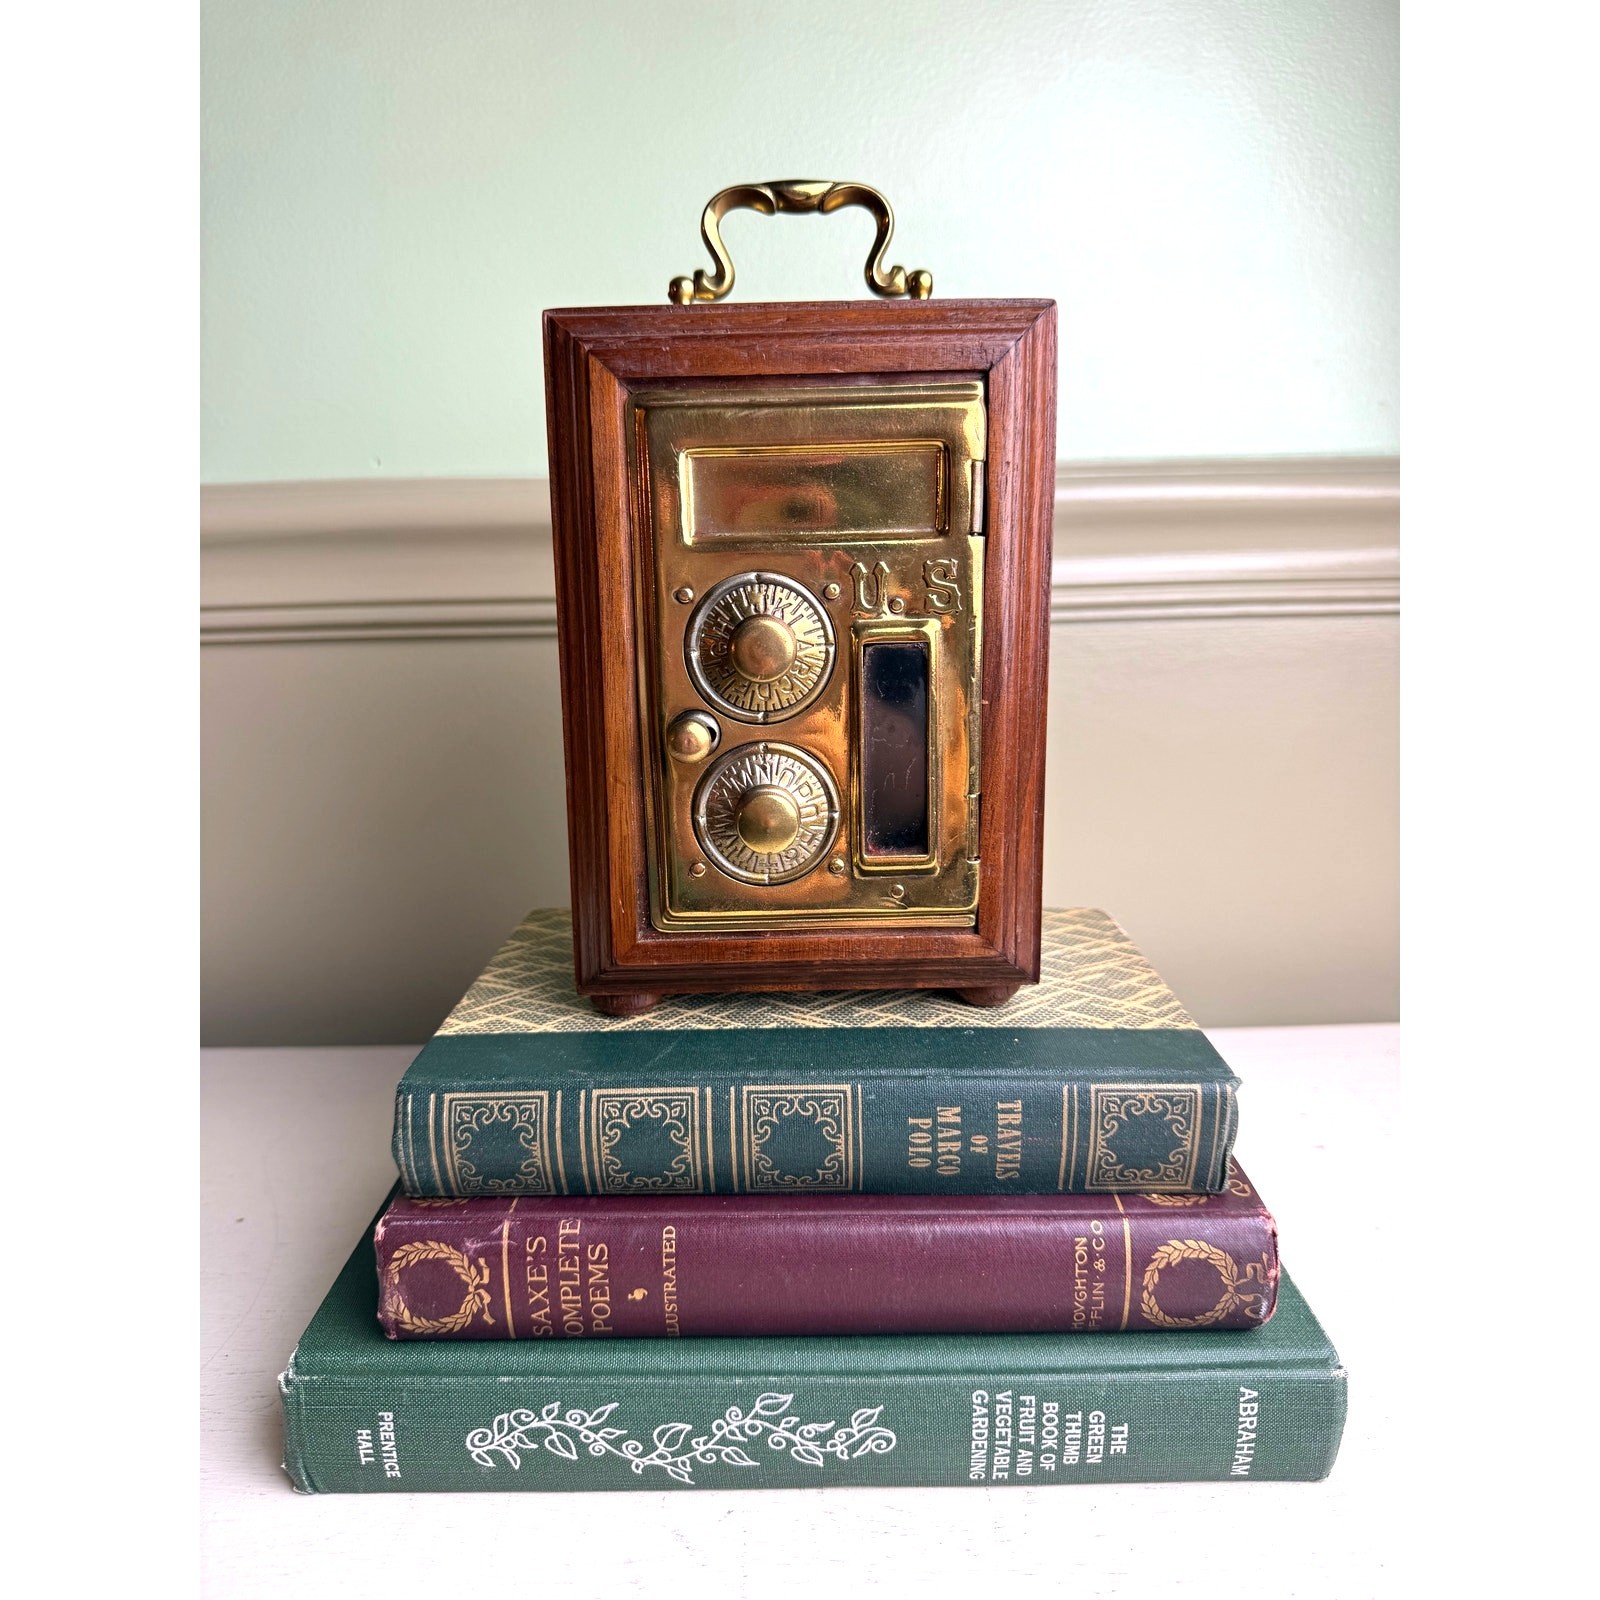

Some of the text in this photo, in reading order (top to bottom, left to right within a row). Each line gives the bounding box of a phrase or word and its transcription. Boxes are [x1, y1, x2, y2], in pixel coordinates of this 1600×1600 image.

[908, 1116, 933, 1168] POLO
[936, 1106, 962, 1176] MARCO
[970, 1134, 989, 1154] OF
[995, 1100, 1022, 1179] TRAVELS
[526, 1236, 553, 1337] SAXE'S
[558, 1218, 585, 1337] OMPLETE
[587, 1242, 613, 1333] POEMS
[662, 1225, 680, 1337] LLUSTRATED
[1088, 1281, 1105, 1330] FFLIN
[356, 1429, 375, 1465] HALL
[378, 1411, 402, 1478] PRENTICE
[969, 1389, 989, 1480] GARDENING
[992, 1390, 1012, 1480] VEGETABLE
[1016, 1395, 1036, 1476] FRUIT AND
[1039, 1402, 1059, 1472] BOOK OF
[1062, 1411, 1082, 1465] THUMB
[1086, 1410, 1106, 1464] GREEN
[1110, 1423, 1129, 1455] THE
[1230, 1386, 1259, 1475] ABRAHAM
